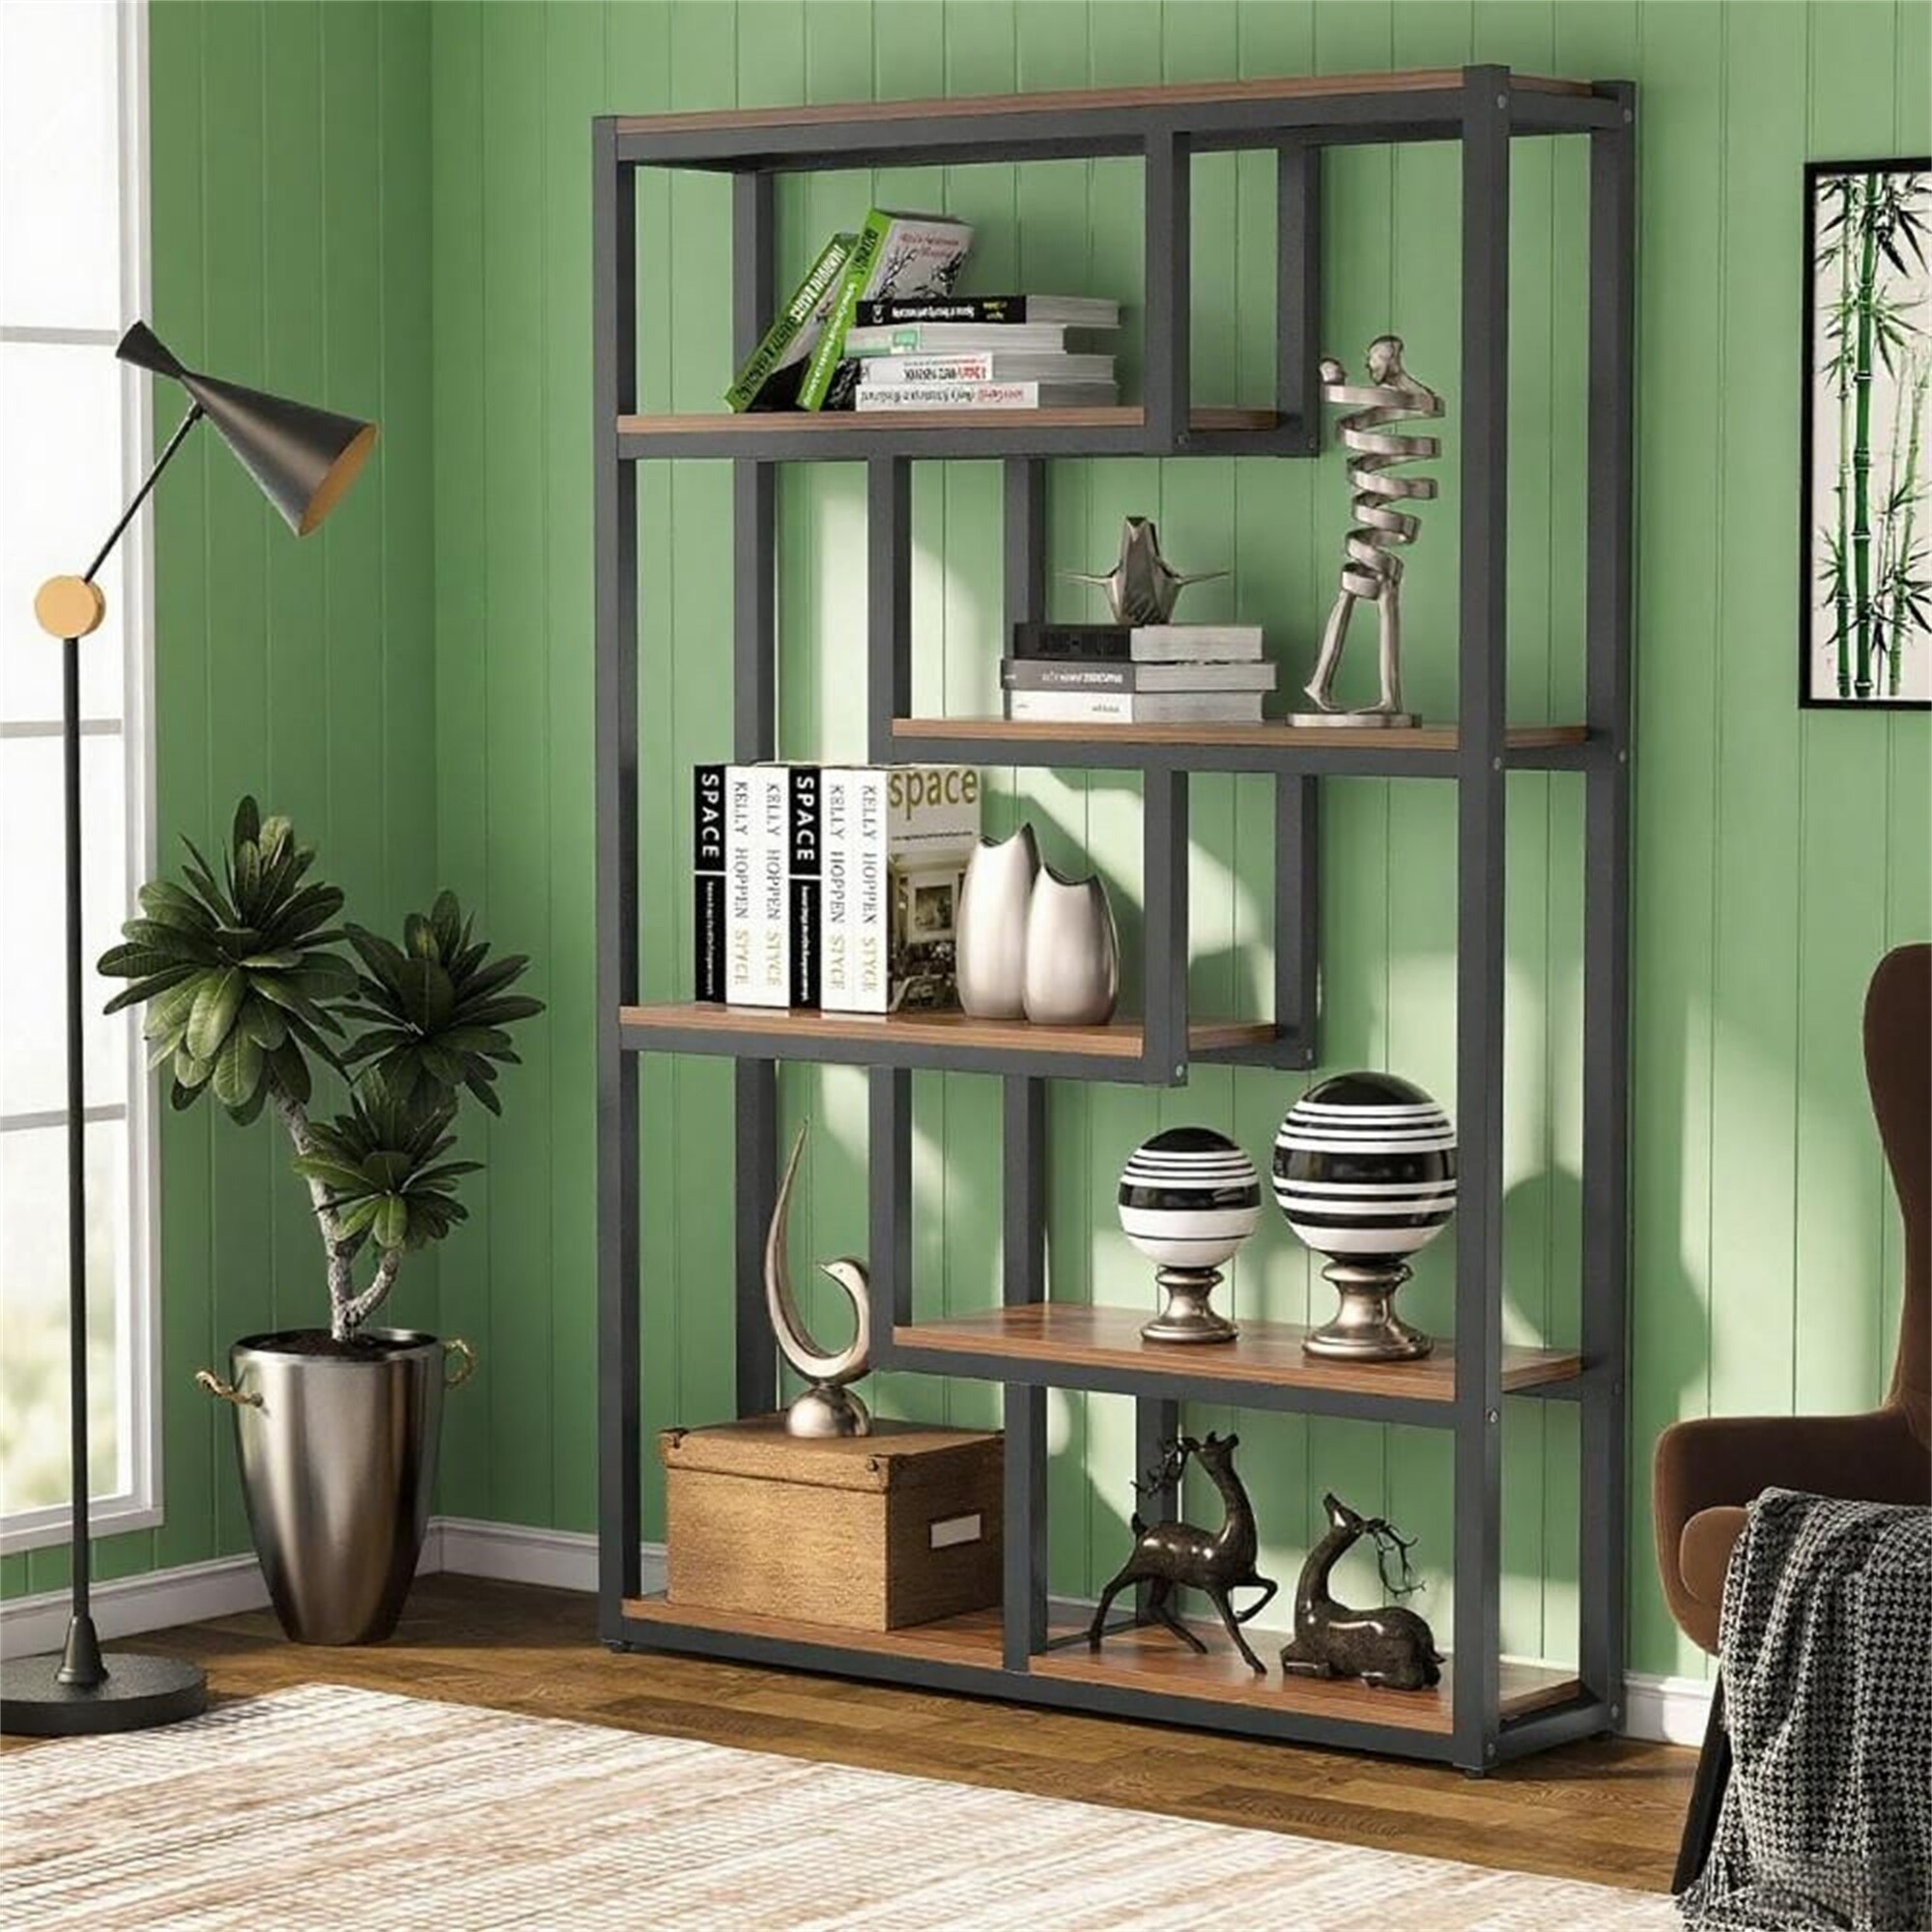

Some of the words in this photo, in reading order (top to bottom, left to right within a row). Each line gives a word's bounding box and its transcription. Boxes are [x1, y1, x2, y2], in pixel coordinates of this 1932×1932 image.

[701, 773, 720, 858] SPACE
[796, 776, 814, 861] SPACE
[890, 770, 978, 820] space
[733, 847, 749, 920] HOPPEN
[766, 849, 781, 921] HOPPEN
[829, 851, 845, 924] HOPPEN
[862, 852, 877, 924] HOPPEN
